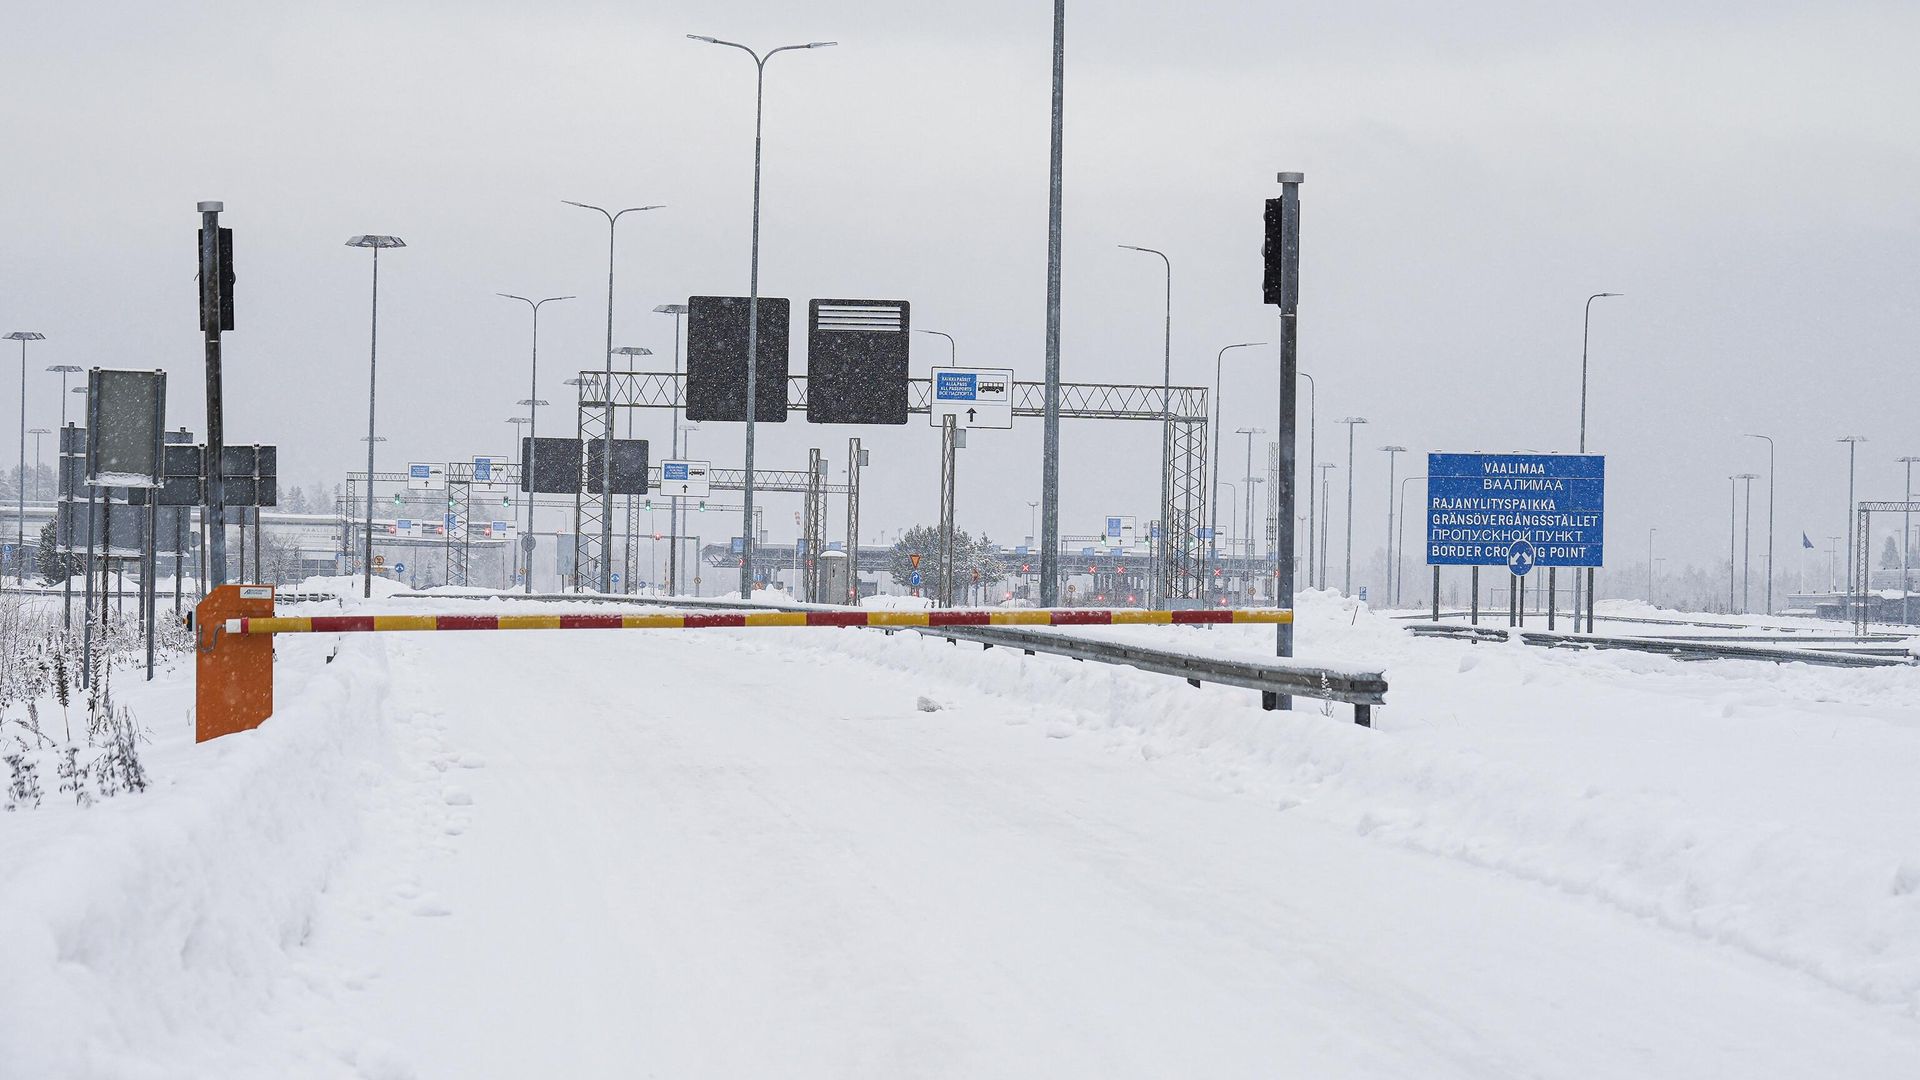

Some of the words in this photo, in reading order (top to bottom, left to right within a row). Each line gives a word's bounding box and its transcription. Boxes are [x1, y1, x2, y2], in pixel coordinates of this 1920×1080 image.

[1484, 462, 1545, 474] VAALIMAA
[1483, 478, 1563, 491] ВААЛИМАА
[1433, 497, 1556, 510] RAJANYLITYSPAIKKA
[1432, 512, 1598, 527] GRÄNSÖVERGÅNGSSTÄLLET
[1432, 528, 1531, 541] ПРОПУСКНОЙ
[1535, 530, 1583, 542] ПУНКТ
[1432, 545, 1482, 557] BORDER
[1485, 546, 1545, 558] CROG
[1550, 547, 1587, 558] POINT
